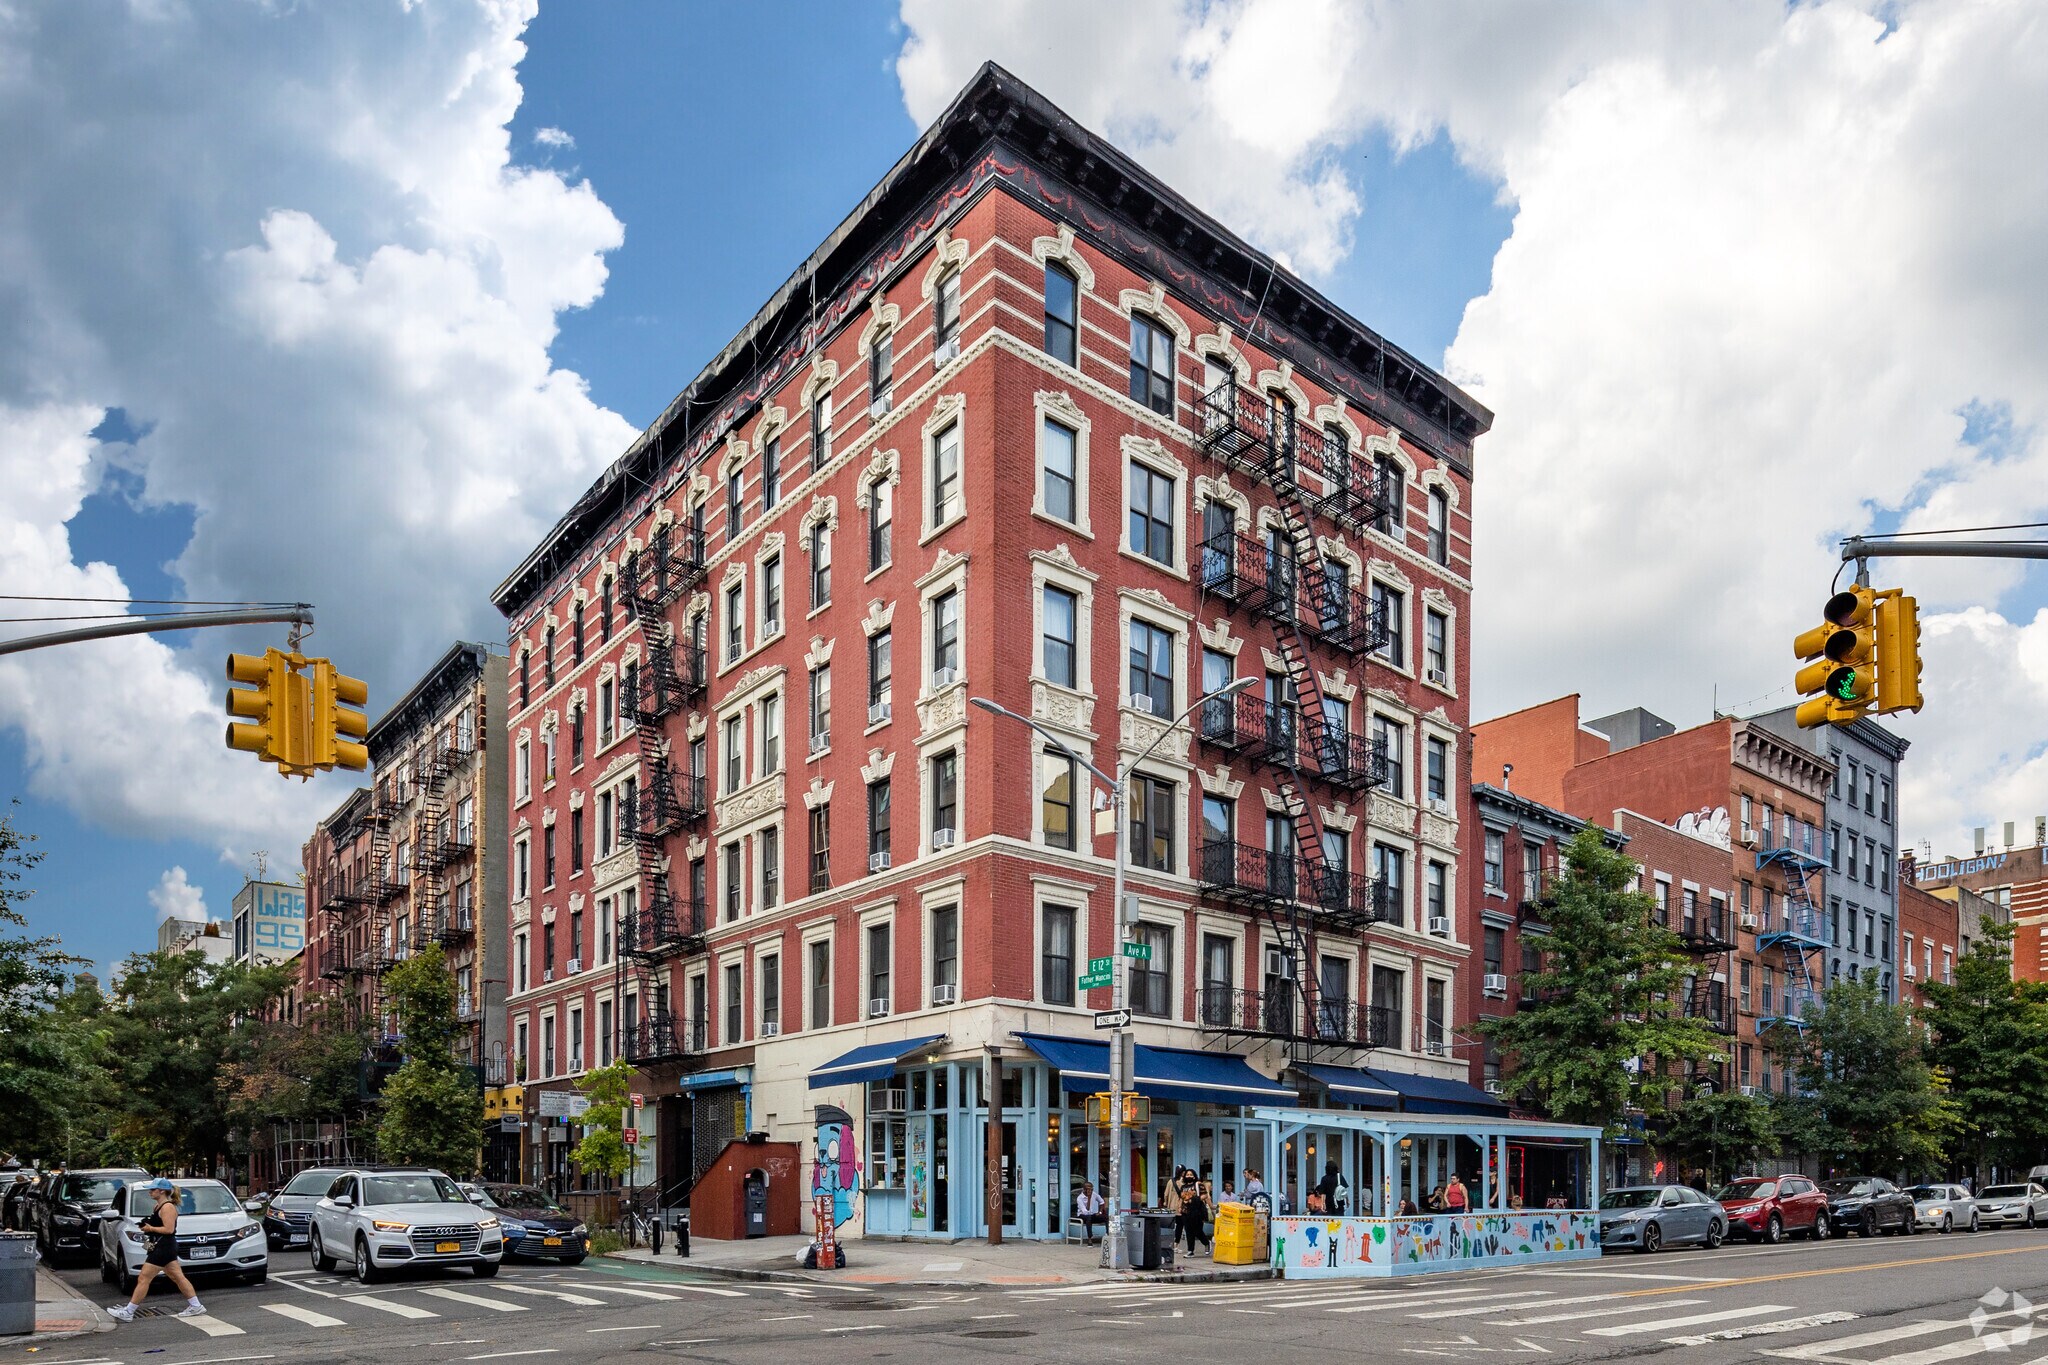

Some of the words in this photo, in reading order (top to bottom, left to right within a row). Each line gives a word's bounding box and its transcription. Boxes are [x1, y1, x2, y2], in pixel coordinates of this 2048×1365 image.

[1127, 944, 1139, 957] Ave
[1141, 946, 1147, 957] A
[1092, 961, 1096, 972] E
[1098, 959, 1104, 971] 12
[1081, 976, 1095, 985] Father
[1095, 973, 1111, 983] Mancini
[1099, 1016, 1110, 1025] ONE
[1114, 1014, 1126, 1024] WAY
